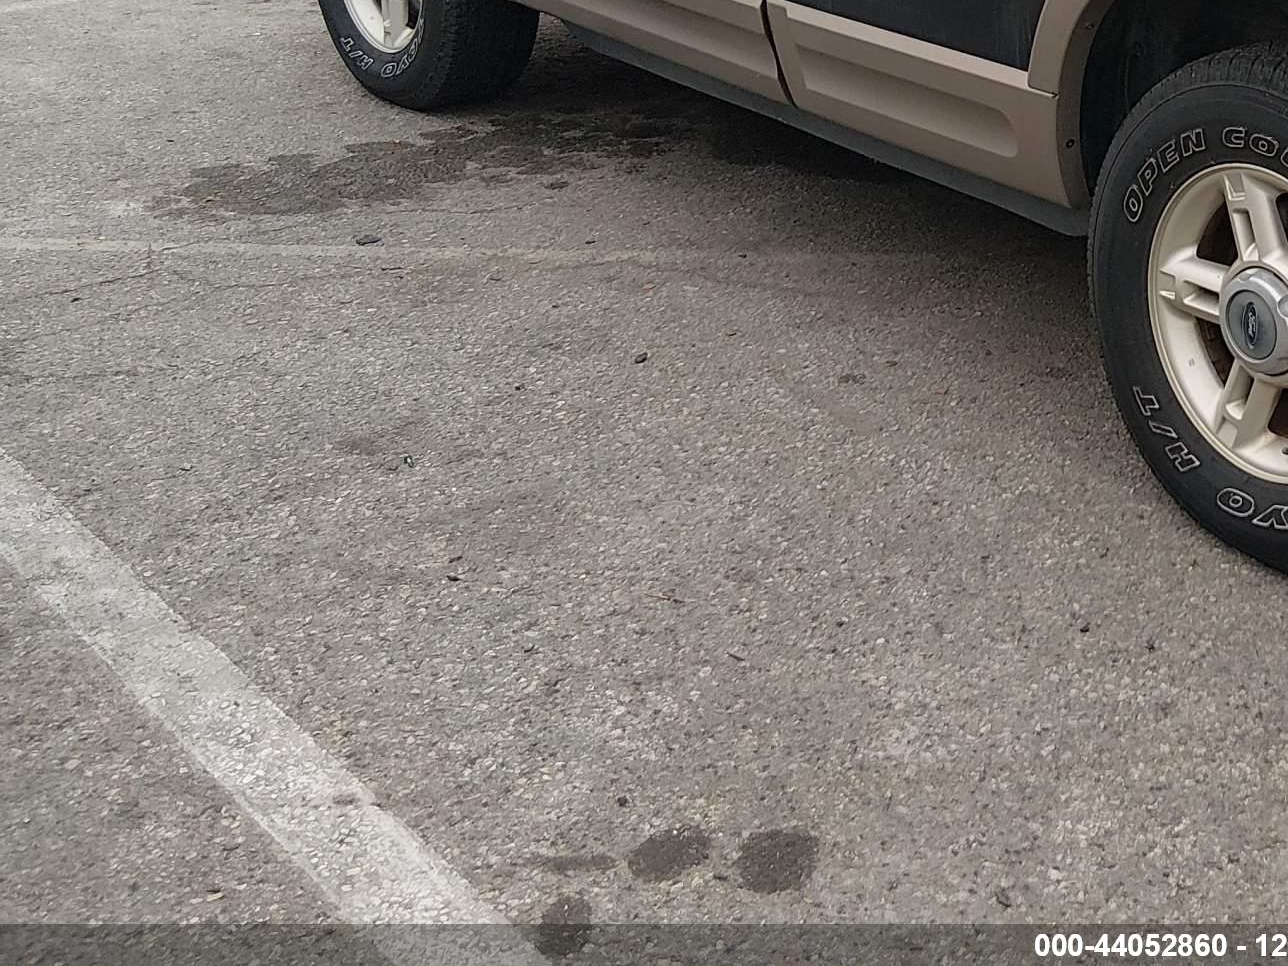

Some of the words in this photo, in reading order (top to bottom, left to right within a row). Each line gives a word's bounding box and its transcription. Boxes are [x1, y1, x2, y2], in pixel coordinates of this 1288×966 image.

[339, 36, 375, 71] H/T
[1123, 127, 1207, 224] OPEN
[1132, 385, 1201, 473] H/T
